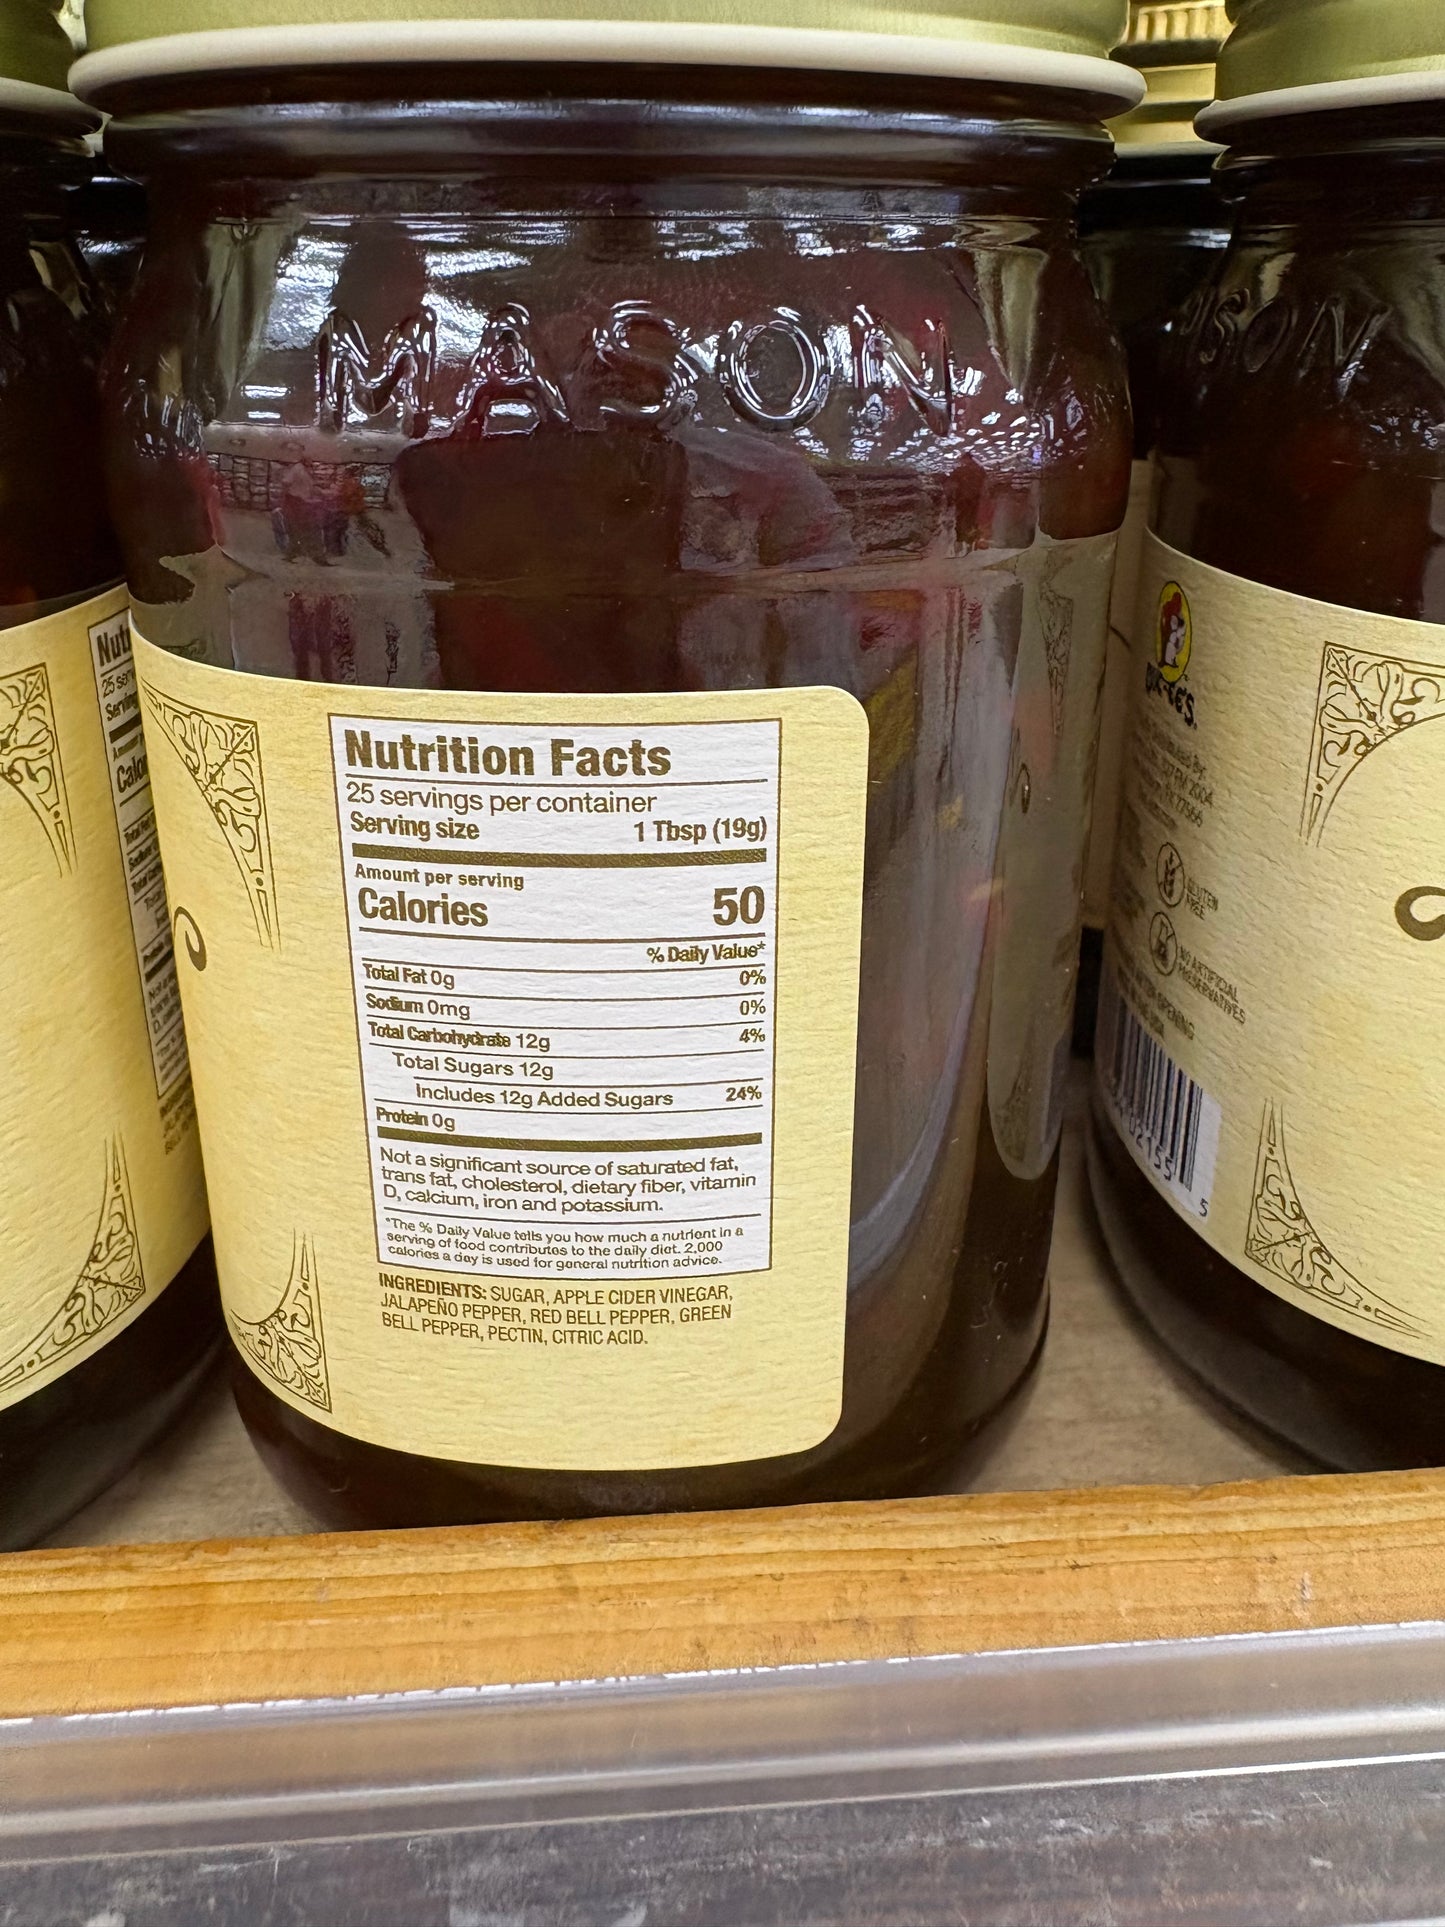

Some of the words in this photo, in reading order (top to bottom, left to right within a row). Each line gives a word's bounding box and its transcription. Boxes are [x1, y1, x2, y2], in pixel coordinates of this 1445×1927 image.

[312, 300, 956, 440] MASON
[344, 729, 534, 776] Nutrition
[551, 739, 671, 776] Facts
[346, 782, 373, 804] 25
[380, 786, 482, 815] servings
[490, 794, 526, 815] per
[537, 791, 656, 813] container
[351, 812, 430, 840] Serving
[436, 817, 479, 839] size
[634, 821, 643, 842] 1
[653, 820, 706, 844] Tbsp
[713, 817, 767, 844] (19g)
[355, 864, 418, 884] Amount
[424, 871, 453, 887] per
[459, 872, 524, 890] serving
[359, 887, 488, 927] Calories
[713, 886, 765, 925] 50
[648, 948, 663, 963] %
[668, 946, 707, 963] Daily
[363, 963, 399, 983] Total
[403, 968, 427, 985] Fat
[431, 970, 455, 989] 0g
[740, 970, 765, 986] 0%
[366, 993, 423, 1014] Sodium
[428, 1000, 470, 1020] 0mg
[740, 1000, 765, 1015] 0%
[368, 1021, 403, 1041] Total
[408, 1025, 511, 1048] Carbohydrate
[516, 1034, 550, 1052] 12g
[740, 1029, 765, 1044] 4%
[393, 1052, 438, 1072] Total
[444, 1057, 513, 1077] Sugars
[519, 1063, 554, 1080] 12g
[416, 1084, 494, 1104] Includes
[500, 1090, 533, 1108] 12g
[537, 1091, 599, 1107] Added
[604, 1091, 673, 1110] Sugars
[726, 1087, 761, 1102] 24%
[376, 1107, 428, 1127] Protein
[432, 1114, 455, 1131] 0g
[380, 1147, 410, 1165] Not
[415, 1154, 426, 1166] a
[430, 1154, 523, 1176] significant
[527, 1162, 590, 1176] source
[594, 1160, 614, 1176] of
[617, 1158, 705, 1175] saturated
[709, 1157, 739, 1173] fat,
[382, 1166, 426, 1184] trans
[430, 1170, 457, 1189] fat,
[462, 1175, 567, 1195] cholesterol,
[572, 1178, 636, 1197] dietary
[640, 1177, 686, 1194] fiber,
[690, 1174, 756, 1191] vitamin
[384, 1185, 401, 1201] D,
[405, 1190, 479, 1209] calcium,
[483, 1196, 517, 1210] iron
[522, 1197, 557, 1211] and
[561, 1197, 663, 1214] potassium.
[387, 1232, 435, 1248] serving
[438, 1236, 451, 1248] of
[454, 1239, 485, 1252] food
[489, 1242, 568, 1256] contributes
[571, 1245, 587, 1256] to
[588, 1244, 610, 1256] the
[614, 1244, 647, 1259] daily
[419, 1222, 433, 1235] %
[437, 1223, 470, 1237] Daily
[474, 1227, 510, 1240] Value
[514, 1229, 542, 1242] tells
[546, 1231, 571, 1245] you
[574, 1230, 604, 1243] how
[609, 1229, 646, 1243] much
[651, 1232, 659, 1241] a
[662, 1227, 716, 1241] nutrient
[720, 1226, 732, 1238] in
[735, 1227, 743, 1236] a
[389, 1244, 439, 1262] calories
[443, 1252, 451, 1262] a
[454, 1253, 478, 1267] day
[482, 1254, 493, 1265] is
[496, 1255, 530, 1267] used
[533, 1256, 553, 1268] for
[556, 1257, 608, 1271] general
[611, 1256, 668, 1269] nutrition
[672, 1254, 722, 1268] advice.
[379, 1273, 487, 1299] INGREDIENTS:
[490, 1287, 549, 1306] SUGAR,
[554, 1289, 604, 1305] APPLE
[608, 1288, 656, 1304] CIDER
[659, 1284, 732, 1303] VINEGAR,
[381, 1293, 458, 1318] JALAPEÑO
[462, 1303, 526, 1325] PEPPER,
[531, 1308, 562, 1324] RED
[566, 1309, 601, 1325] BELL
[609, 1309, 675, 1326] PEPPER,
[679, 1304, 731, 1323] GREEN
[382, 1312, 418, 1332] BELL
[422, 1318, 484, 1342] PEPPER,
[488, 1325, 547, 1345] PECTIN,
[551, 1328, 603, 1345] CITRIC
[607, 1329, 649, 1345] ACID.
